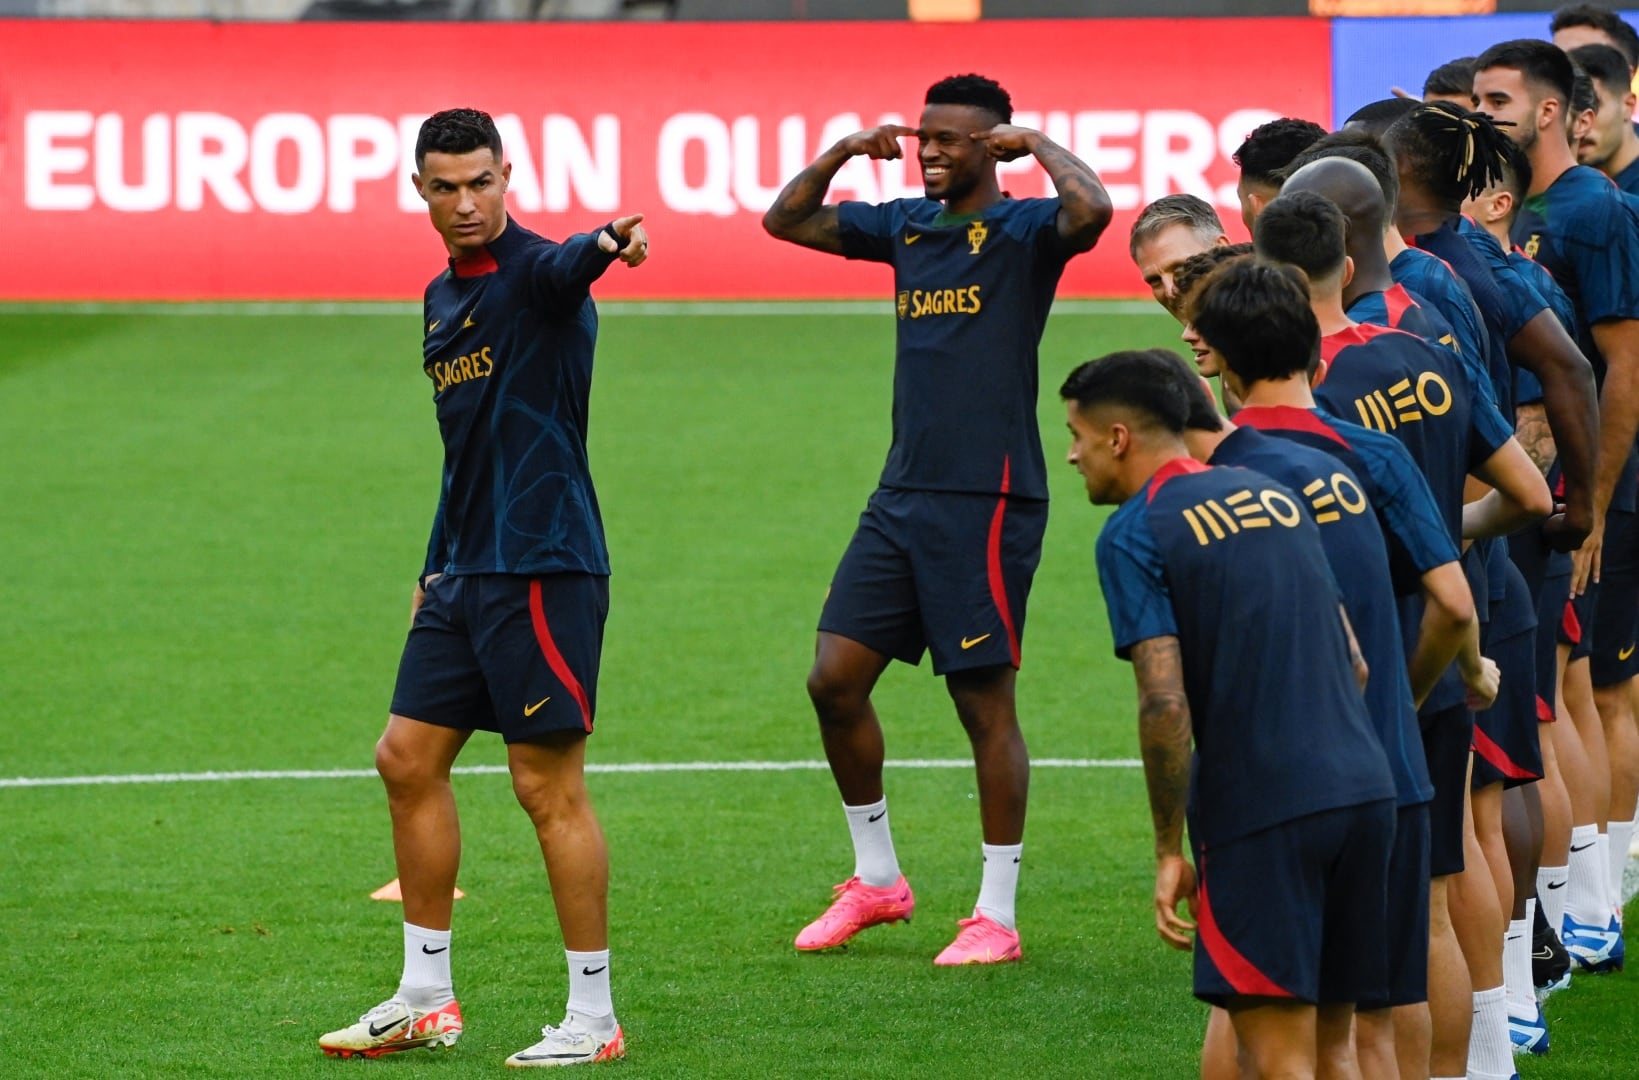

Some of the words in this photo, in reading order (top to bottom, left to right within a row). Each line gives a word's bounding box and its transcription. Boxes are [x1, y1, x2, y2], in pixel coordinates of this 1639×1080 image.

[911, 285, 981, 318] SAGRES
[434, 346, 493, 392] SAGRES
[1355, 371, 1452, 433] MEO
[1183, 490, 1300, 545] MEO
[1303, 473, 1366, 524] EO
